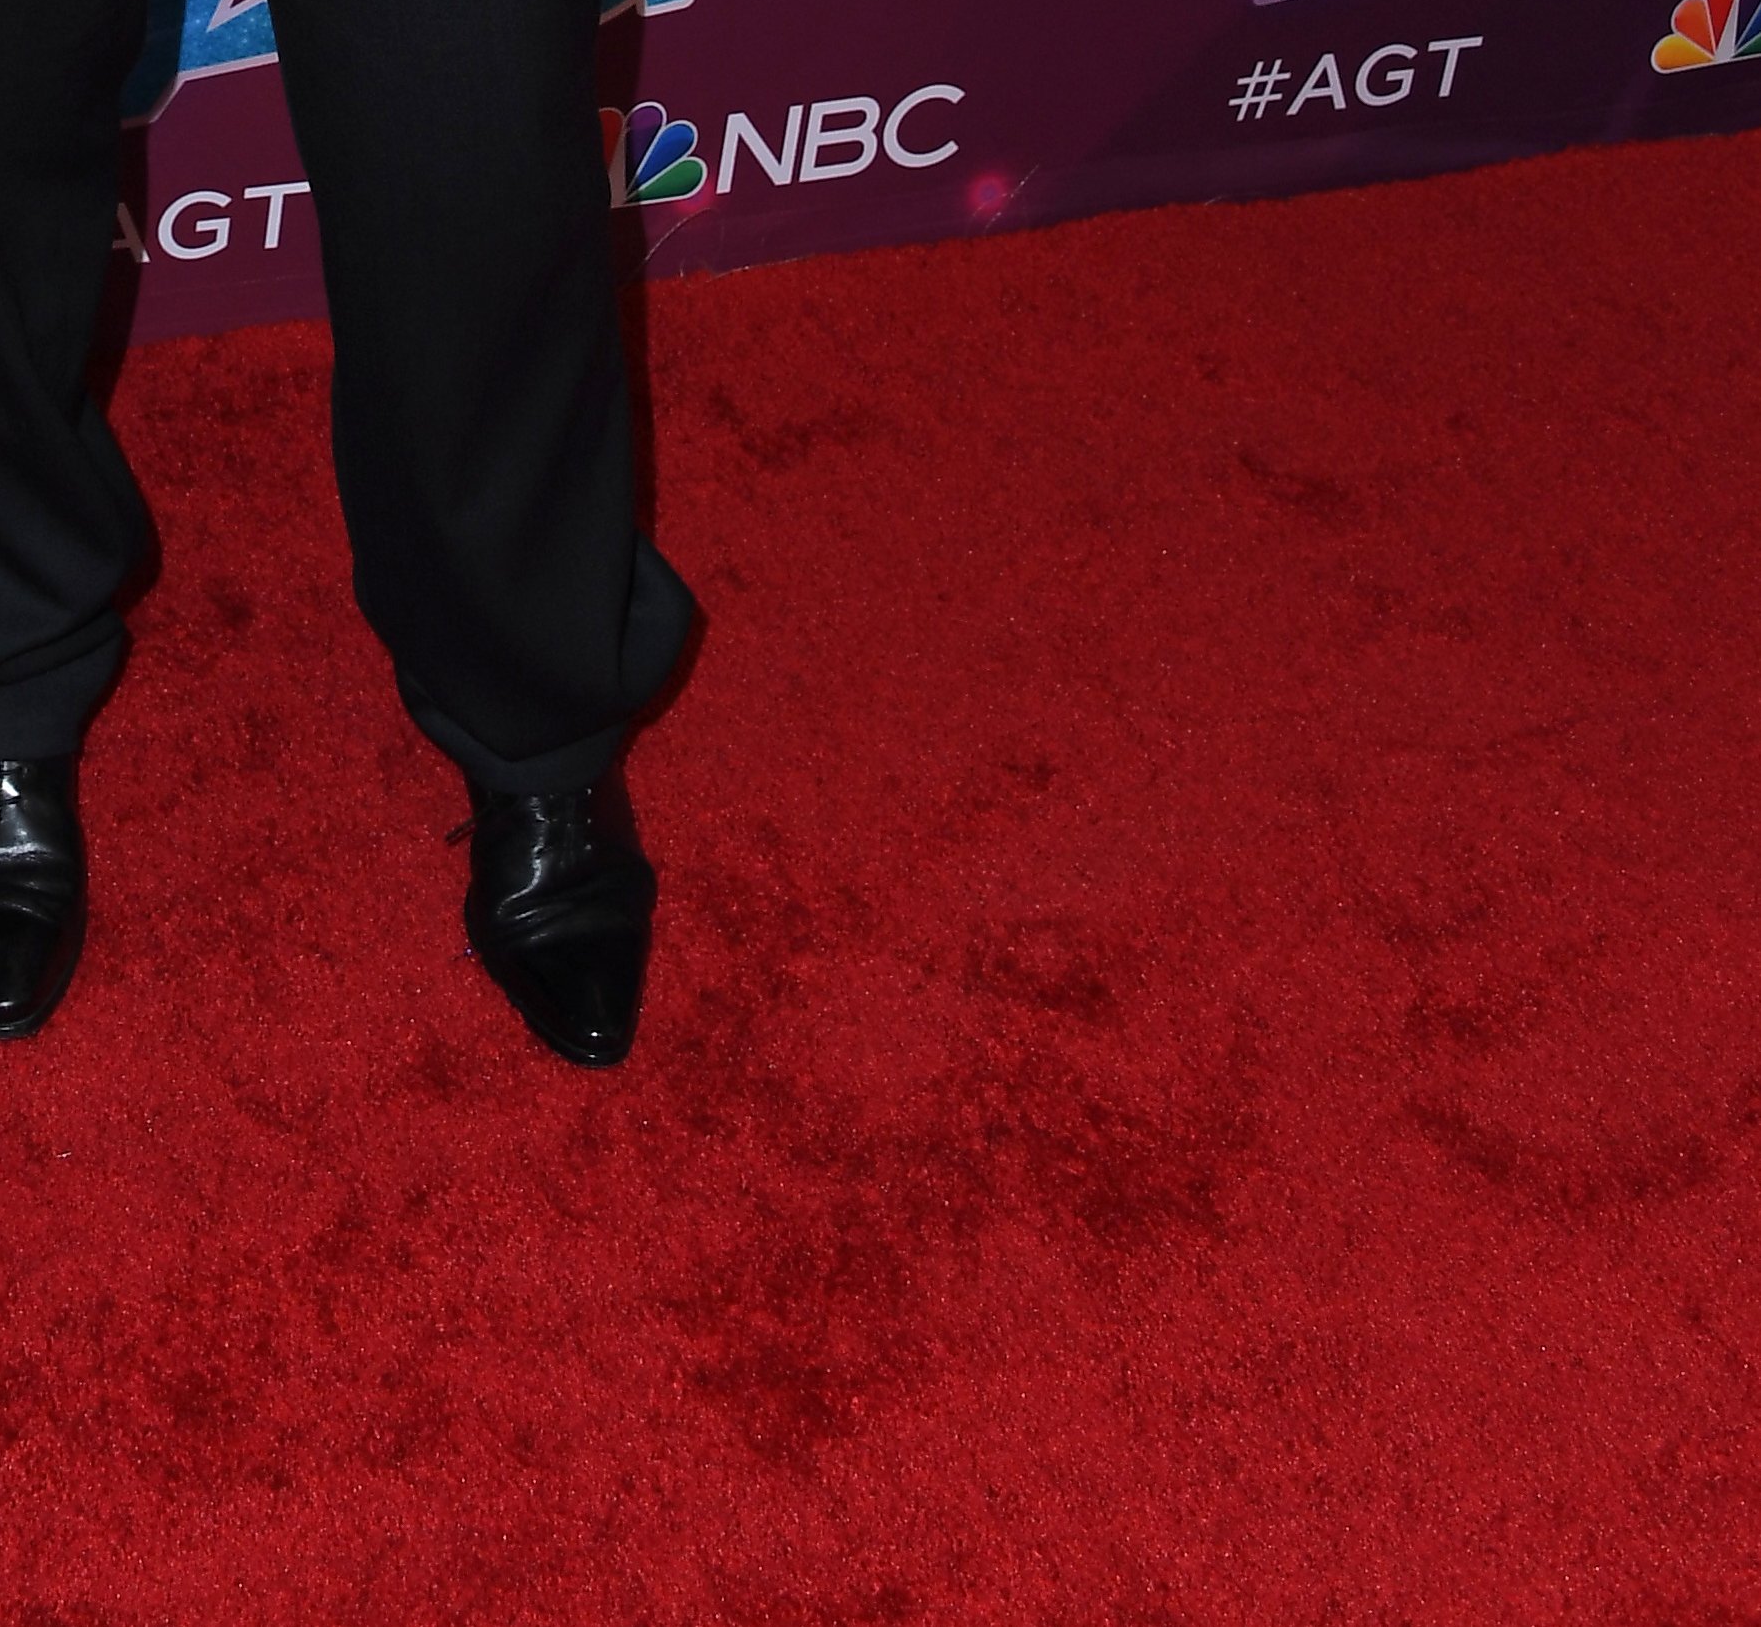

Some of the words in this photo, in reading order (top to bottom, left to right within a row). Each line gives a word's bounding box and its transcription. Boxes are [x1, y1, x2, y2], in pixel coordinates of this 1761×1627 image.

[1229, 37, 1483, 121] #AGT
[717, 85, 965, 194] NBC
[113, 182, 310, 264] AGT
